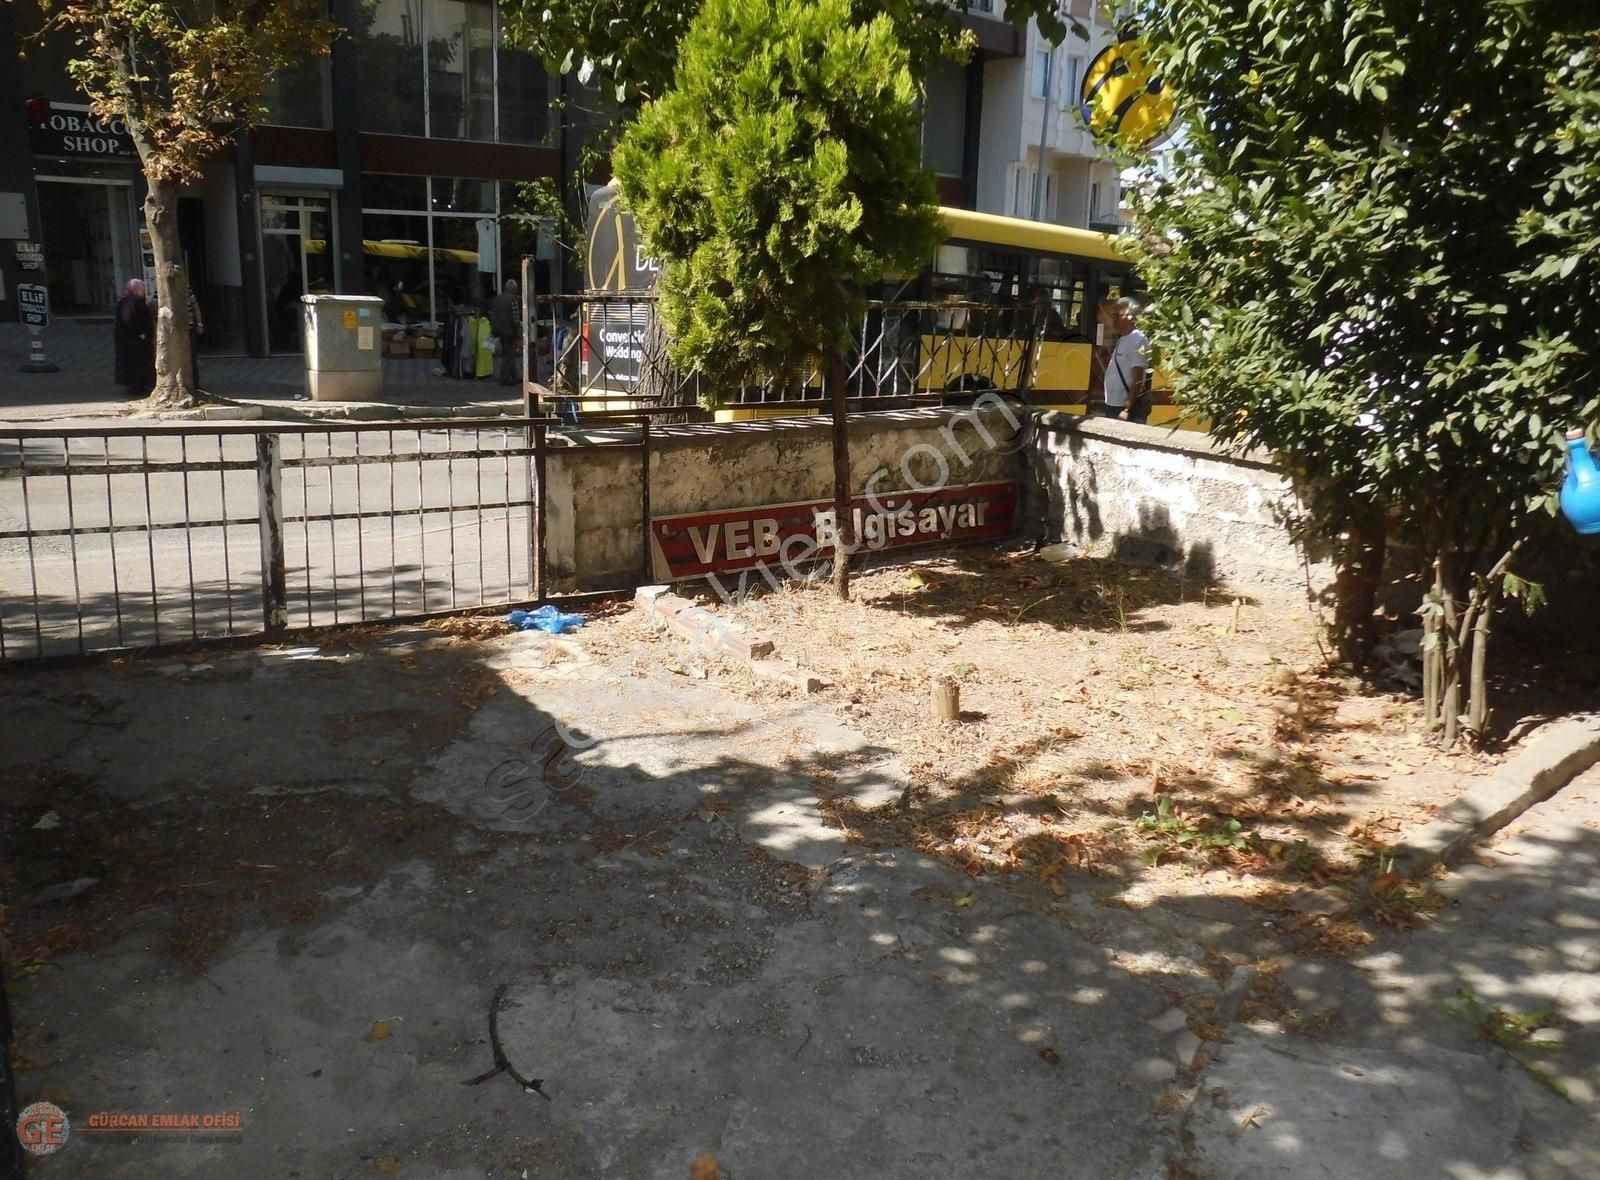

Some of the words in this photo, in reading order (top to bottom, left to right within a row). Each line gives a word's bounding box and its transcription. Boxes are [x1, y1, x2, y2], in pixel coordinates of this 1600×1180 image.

[63, 135, 119, 153] SHOP
[15, 253, 44, 262] TOBACCO
[22, 261, 39, 270] SHOP
[21, 302, 46, 314] TOBACCO
[25, 313, 42, 323] SHOP
[687, 518, 782, 565] VEB
[814, 499, 990, 550] Blgisayar
